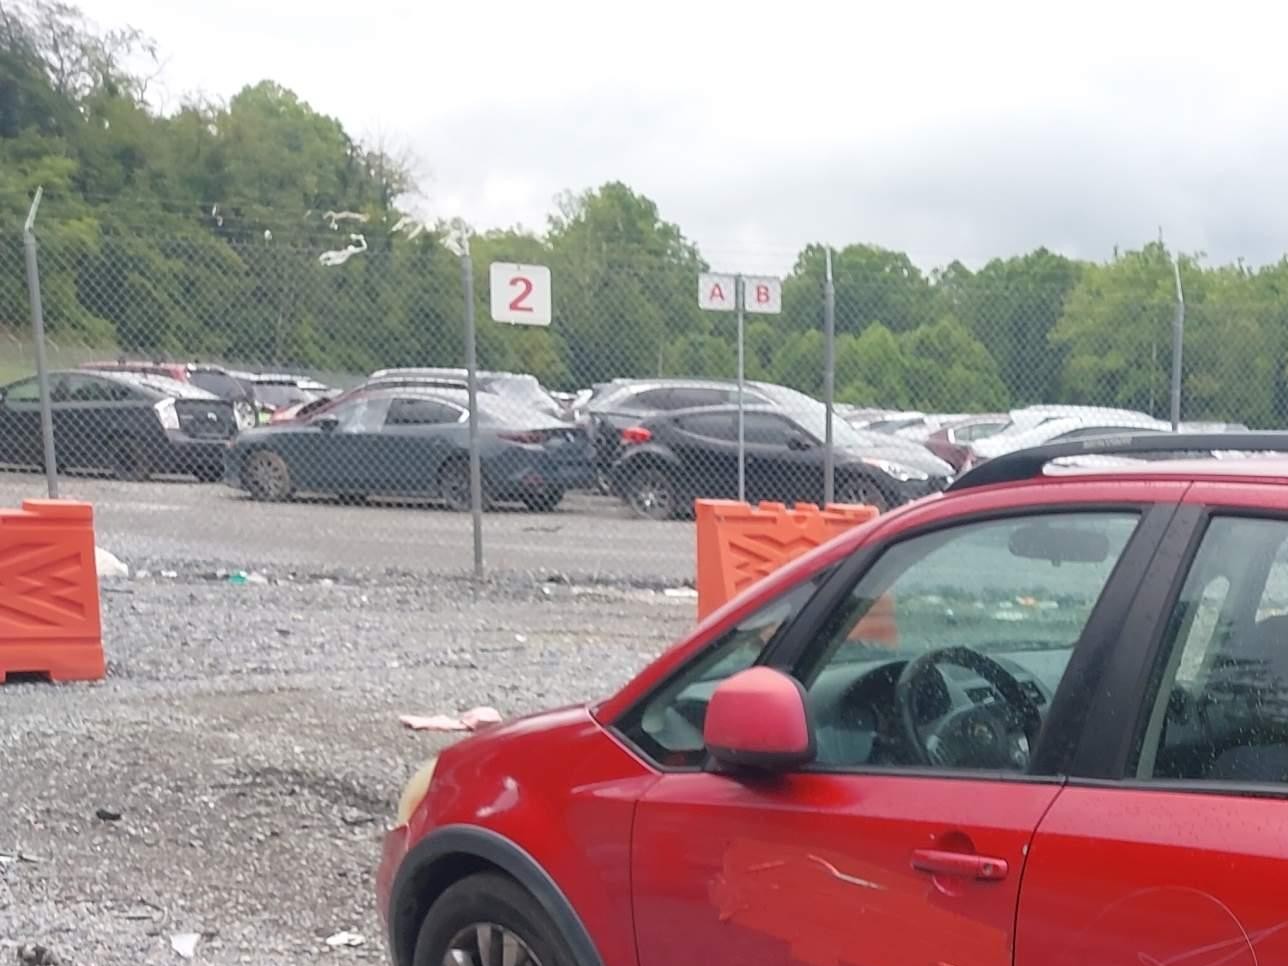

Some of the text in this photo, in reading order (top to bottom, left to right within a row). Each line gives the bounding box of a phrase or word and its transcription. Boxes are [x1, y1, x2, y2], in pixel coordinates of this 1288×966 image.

[508, 276, 534, 312] 2
[708, 283, 726, 301] A
[756, 284, 770, 304] B
